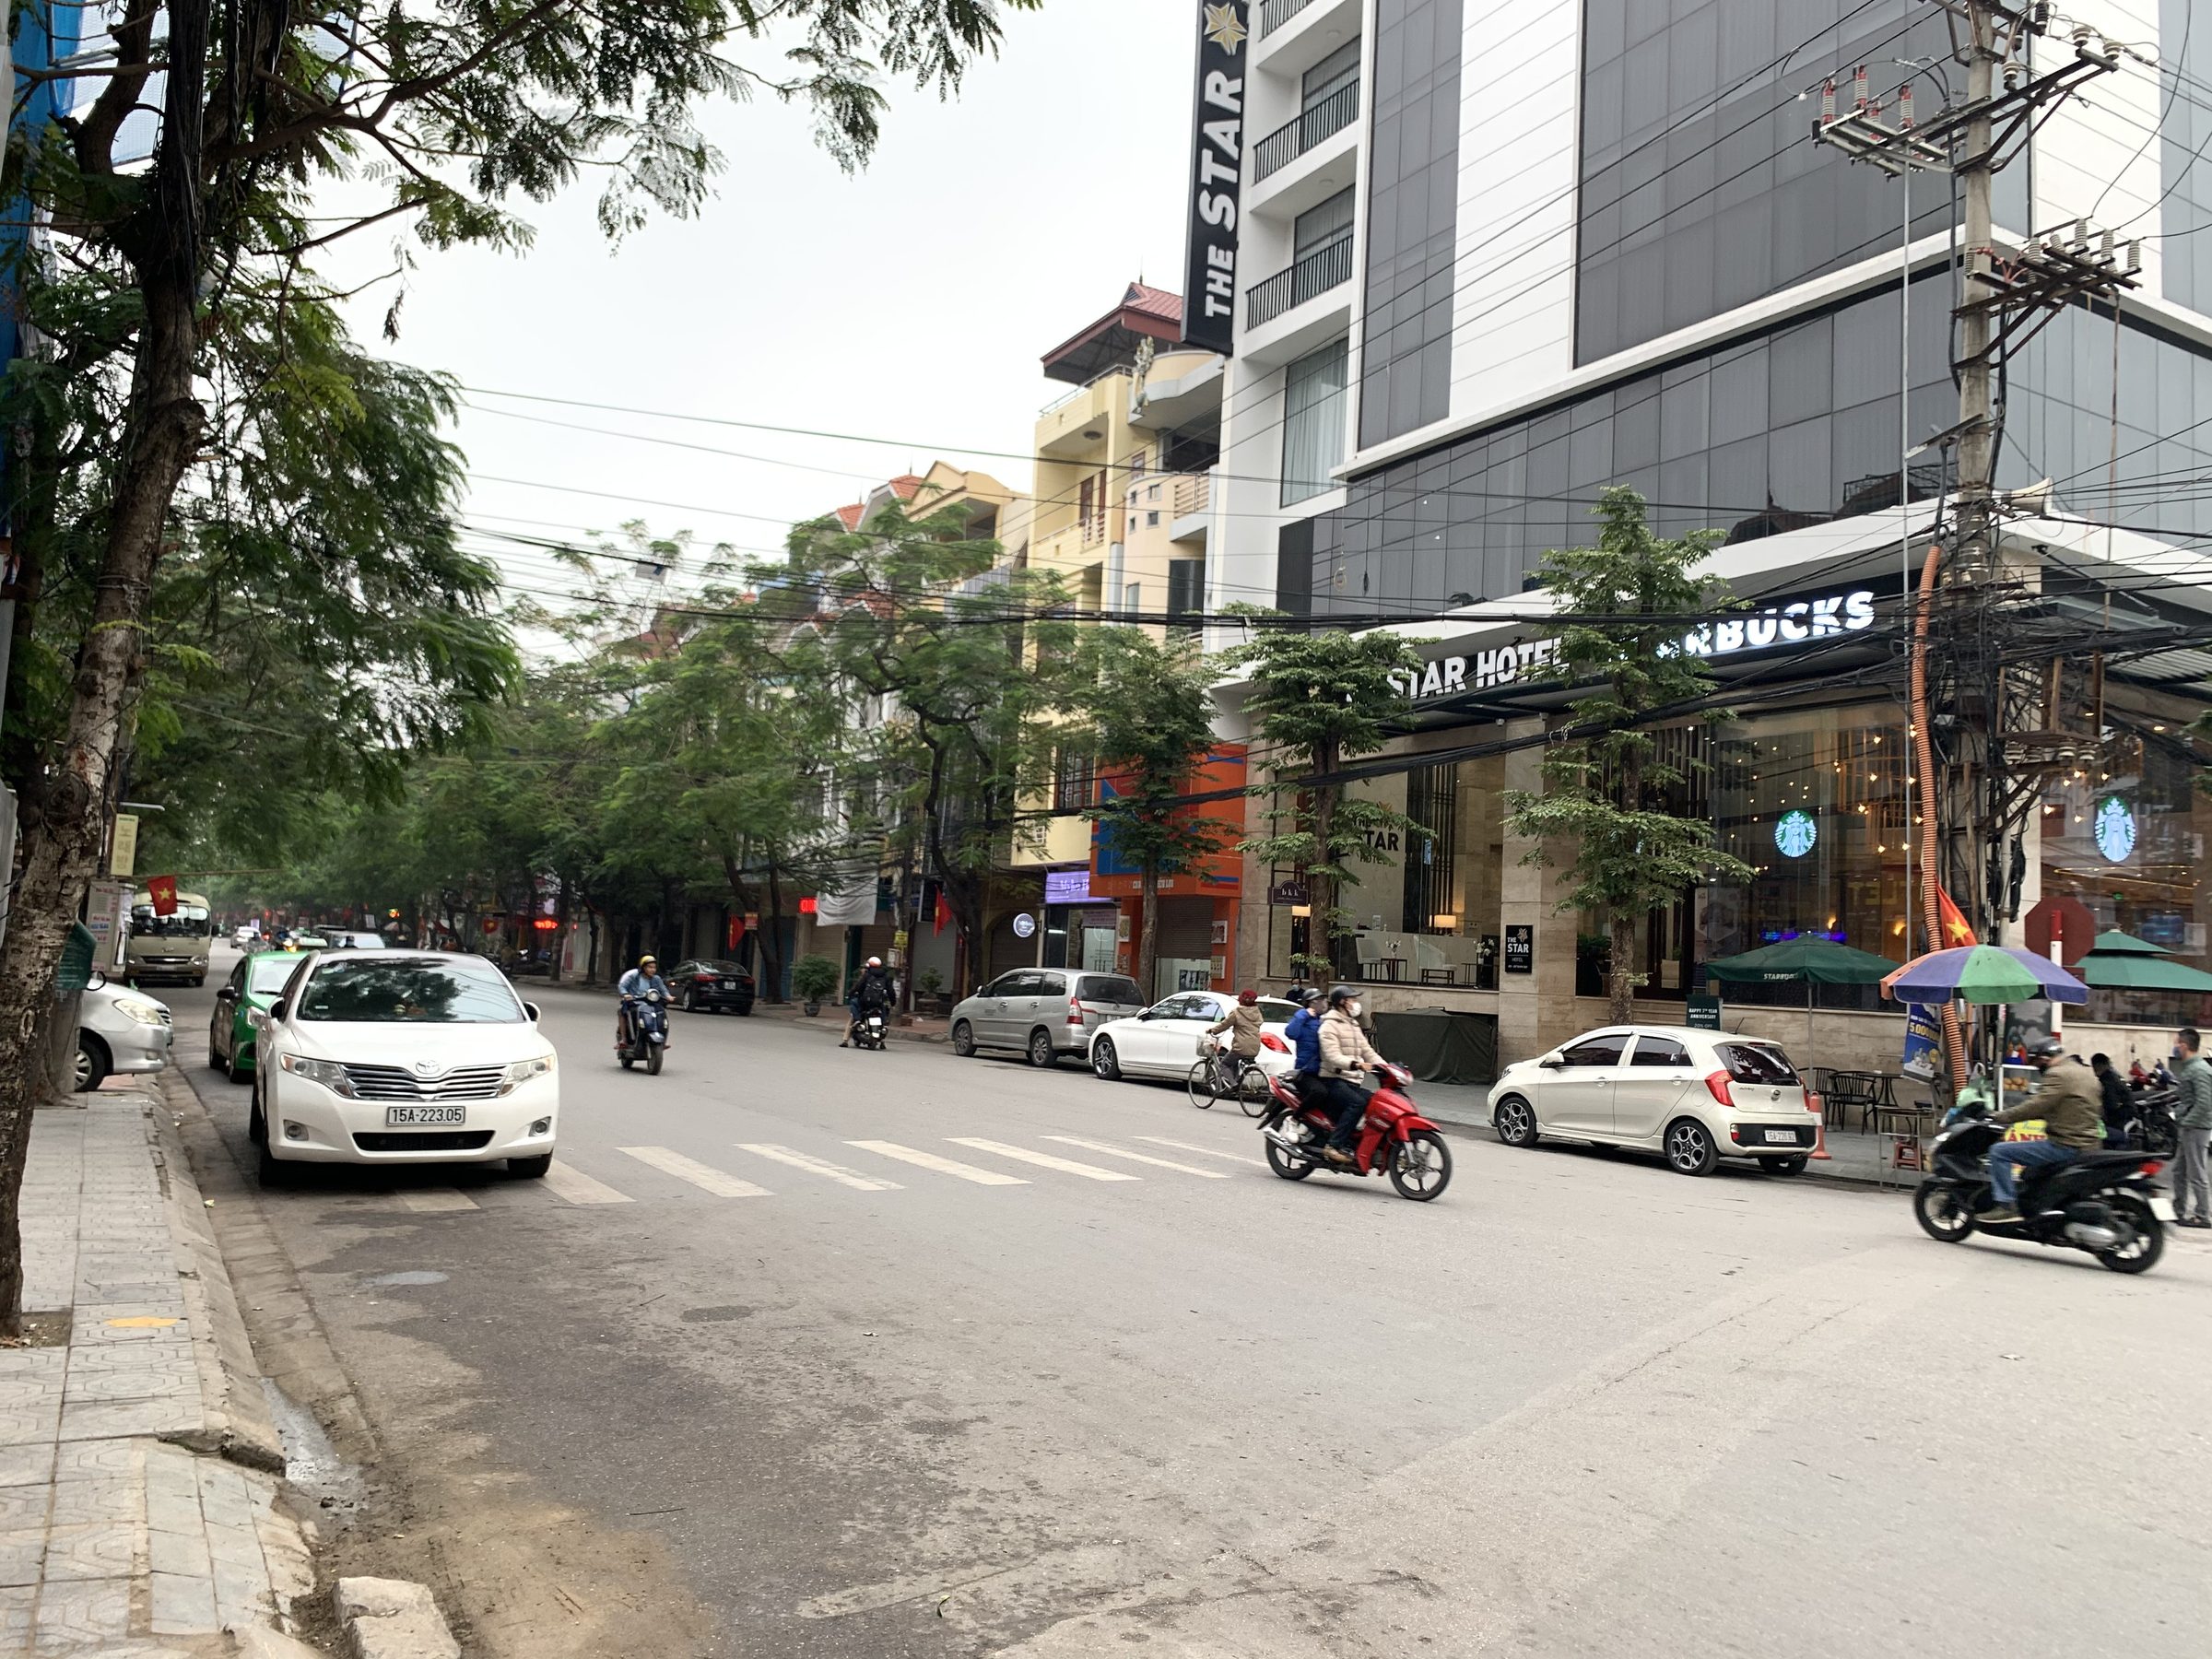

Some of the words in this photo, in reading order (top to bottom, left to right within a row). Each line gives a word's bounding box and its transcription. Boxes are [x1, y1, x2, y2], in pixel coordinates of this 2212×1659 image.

[1199, 70, 1243, 231] STAR
[1205, 244, 1233, 317] THE
[1364, 830, 1399, 851] TAR
[1507, 943, 1529, 953] STAR
[393, 1108, 462, 1122] 15A-223.05
